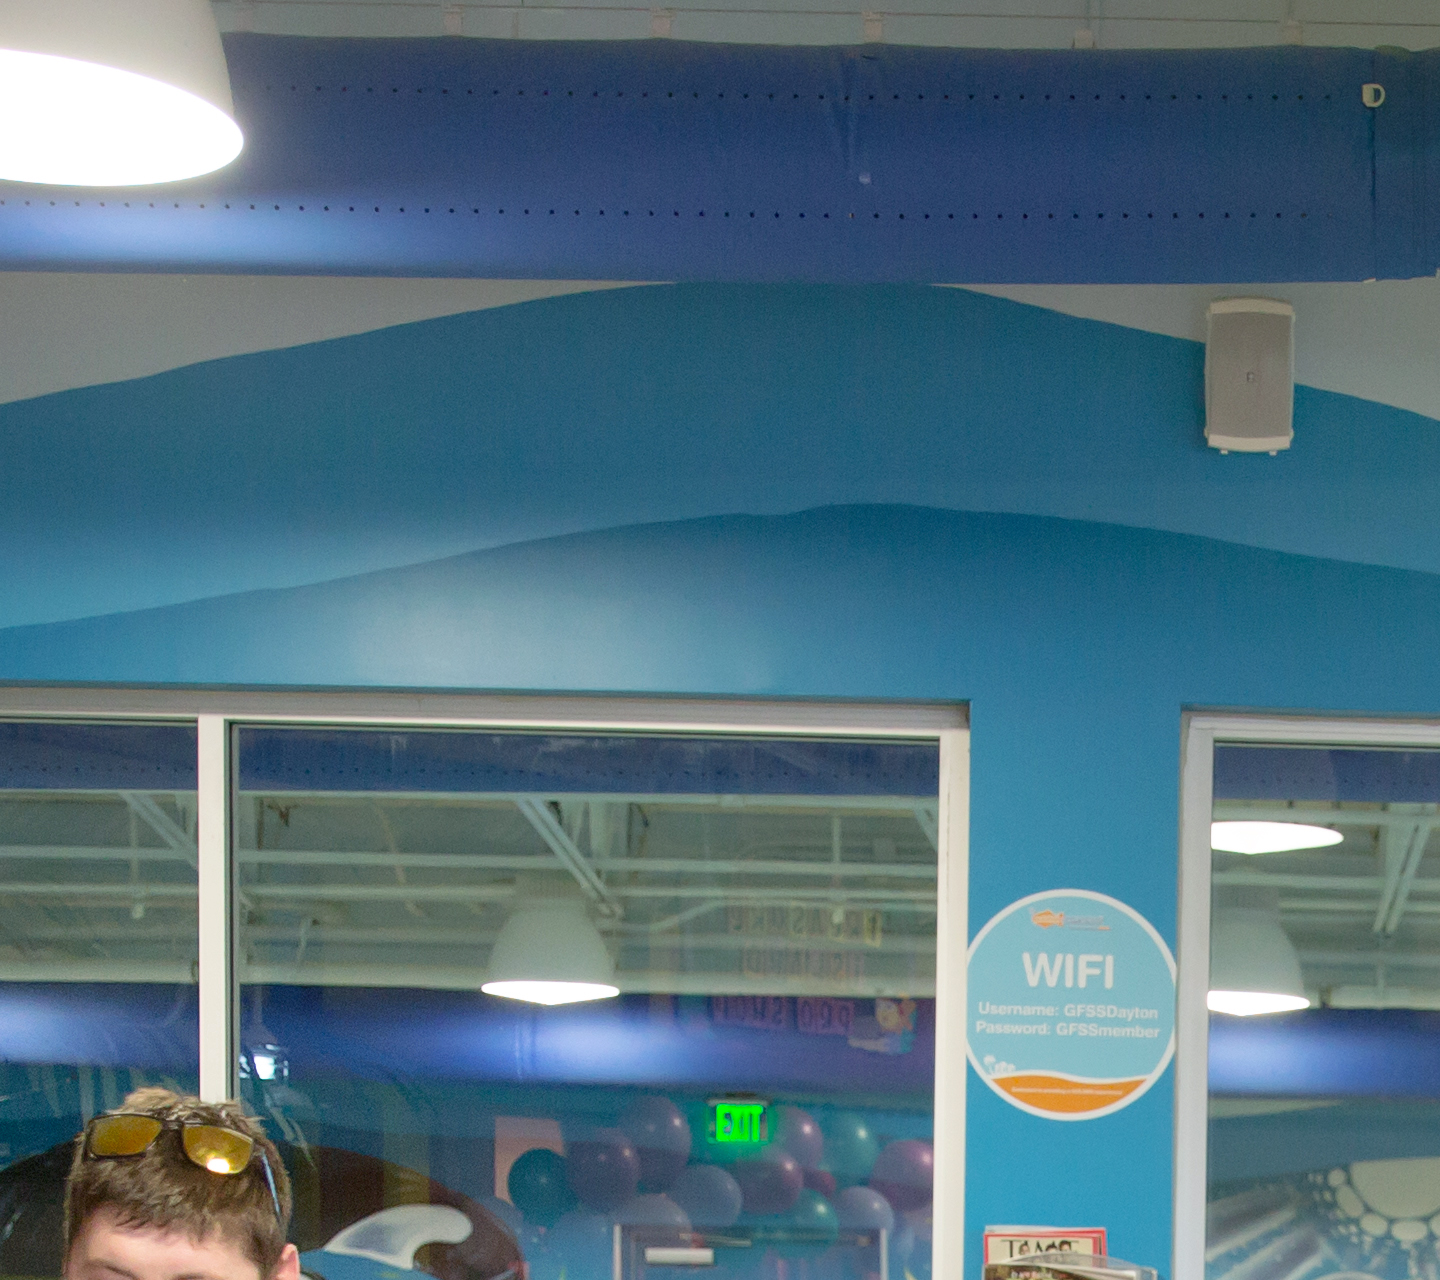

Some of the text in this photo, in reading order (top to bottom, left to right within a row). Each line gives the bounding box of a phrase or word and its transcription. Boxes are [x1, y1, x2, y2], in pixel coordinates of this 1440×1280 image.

[1022, 952, 1114, 989] WIFI
[978, 1001, 1158, 1021] Username: GFSSDayton
[976, 1020, 1160, 1038] Password: GFSSmember
[715, 1103, 764, 1142] EXIT
